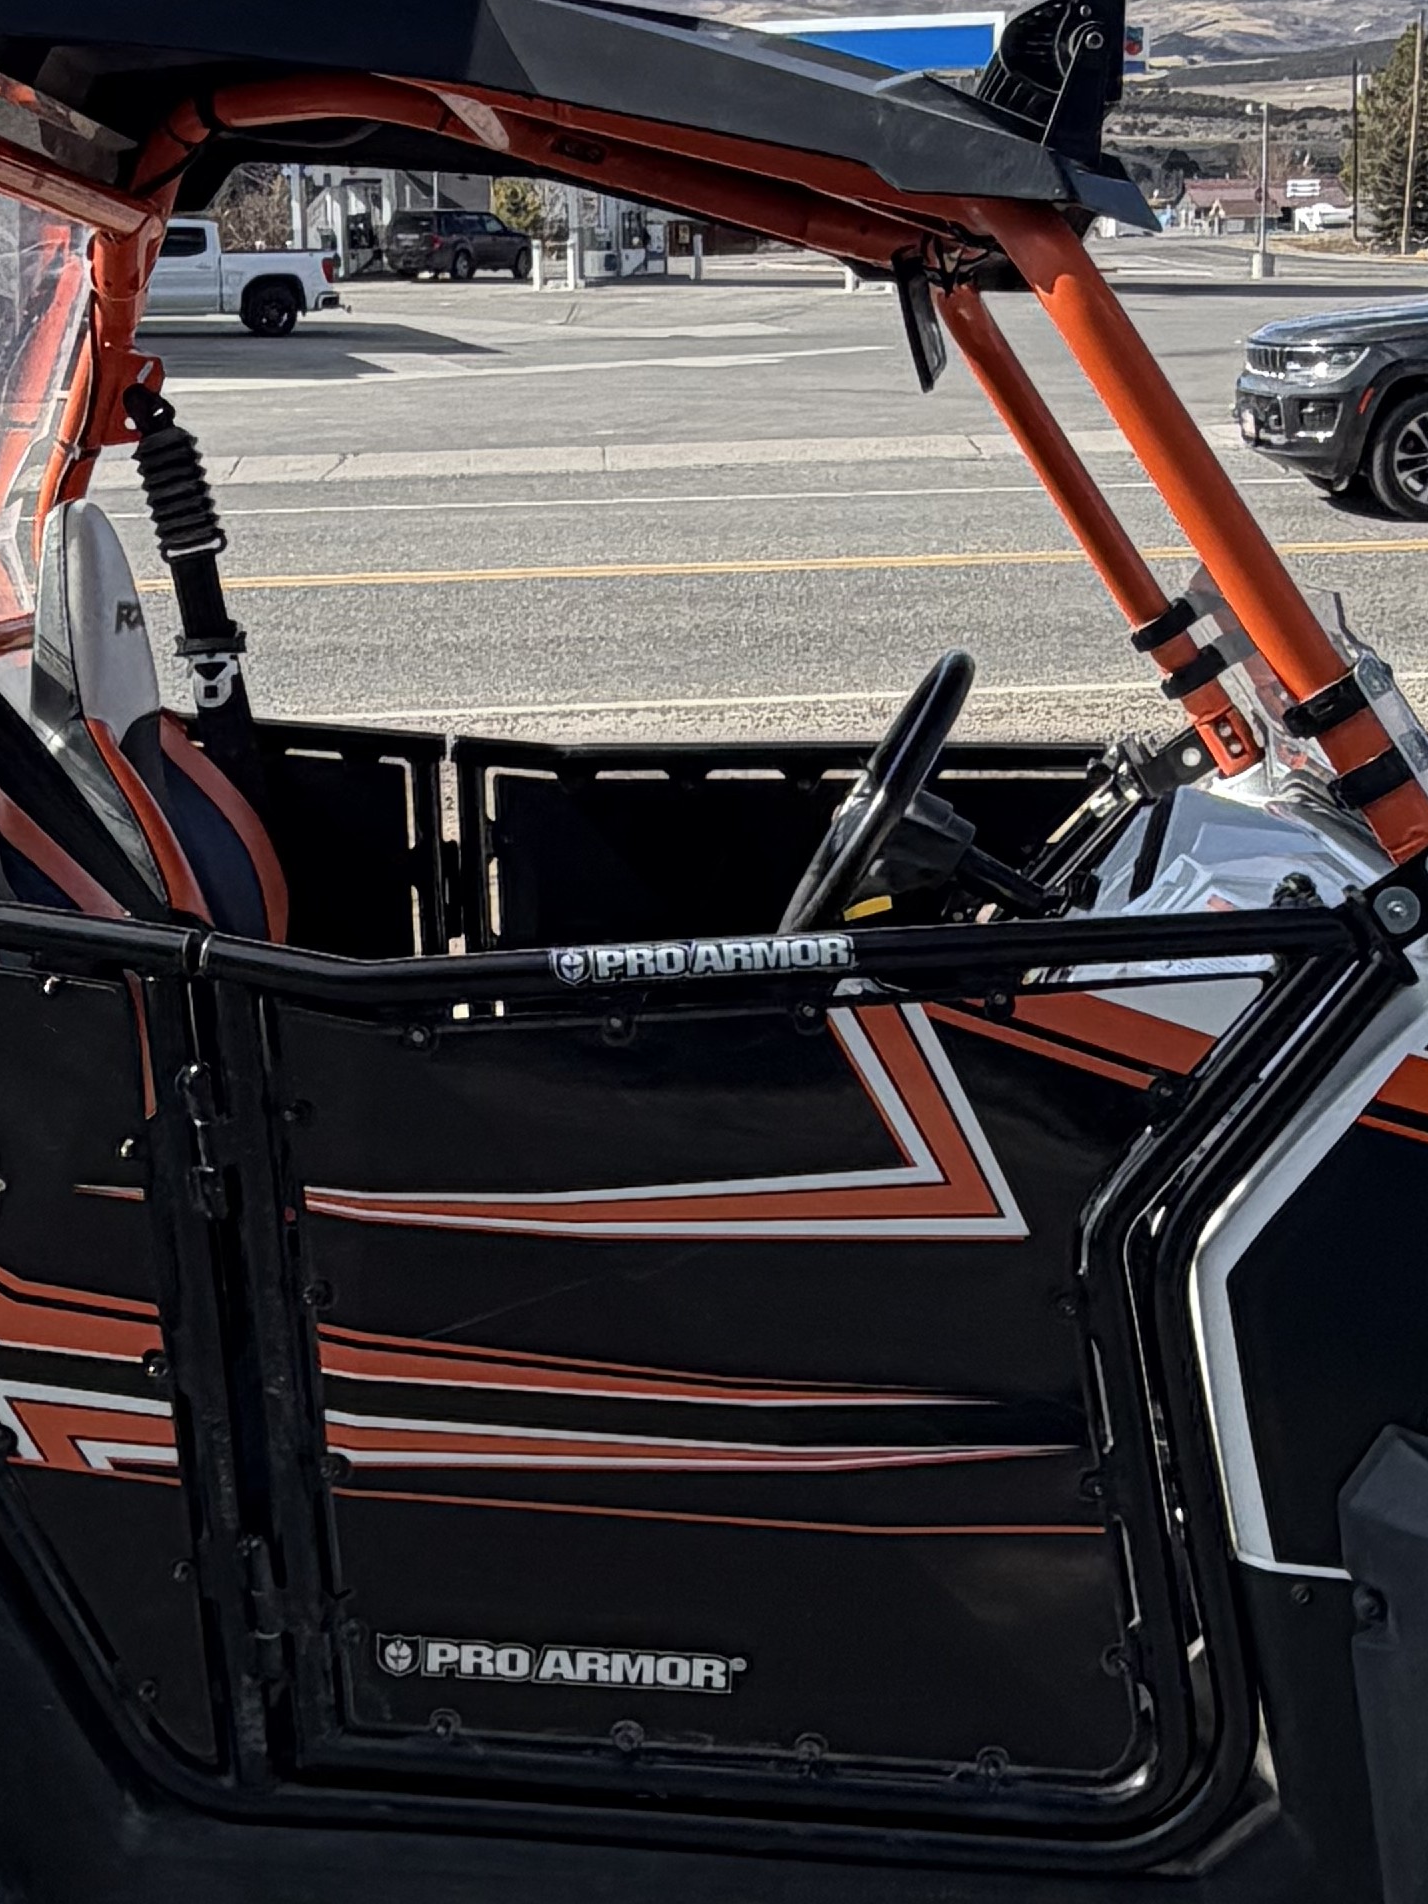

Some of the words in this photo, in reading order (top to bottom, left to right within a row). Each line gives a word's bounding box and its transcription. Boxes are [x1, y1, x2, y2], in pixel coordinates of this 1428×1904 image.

[595, 946, 688, 978] PRO
[692, 937, 850, 973] ARMOR
[425, 1641, 531, 1678] PRO
[537, 1649, 727, 1688] ARMOR
